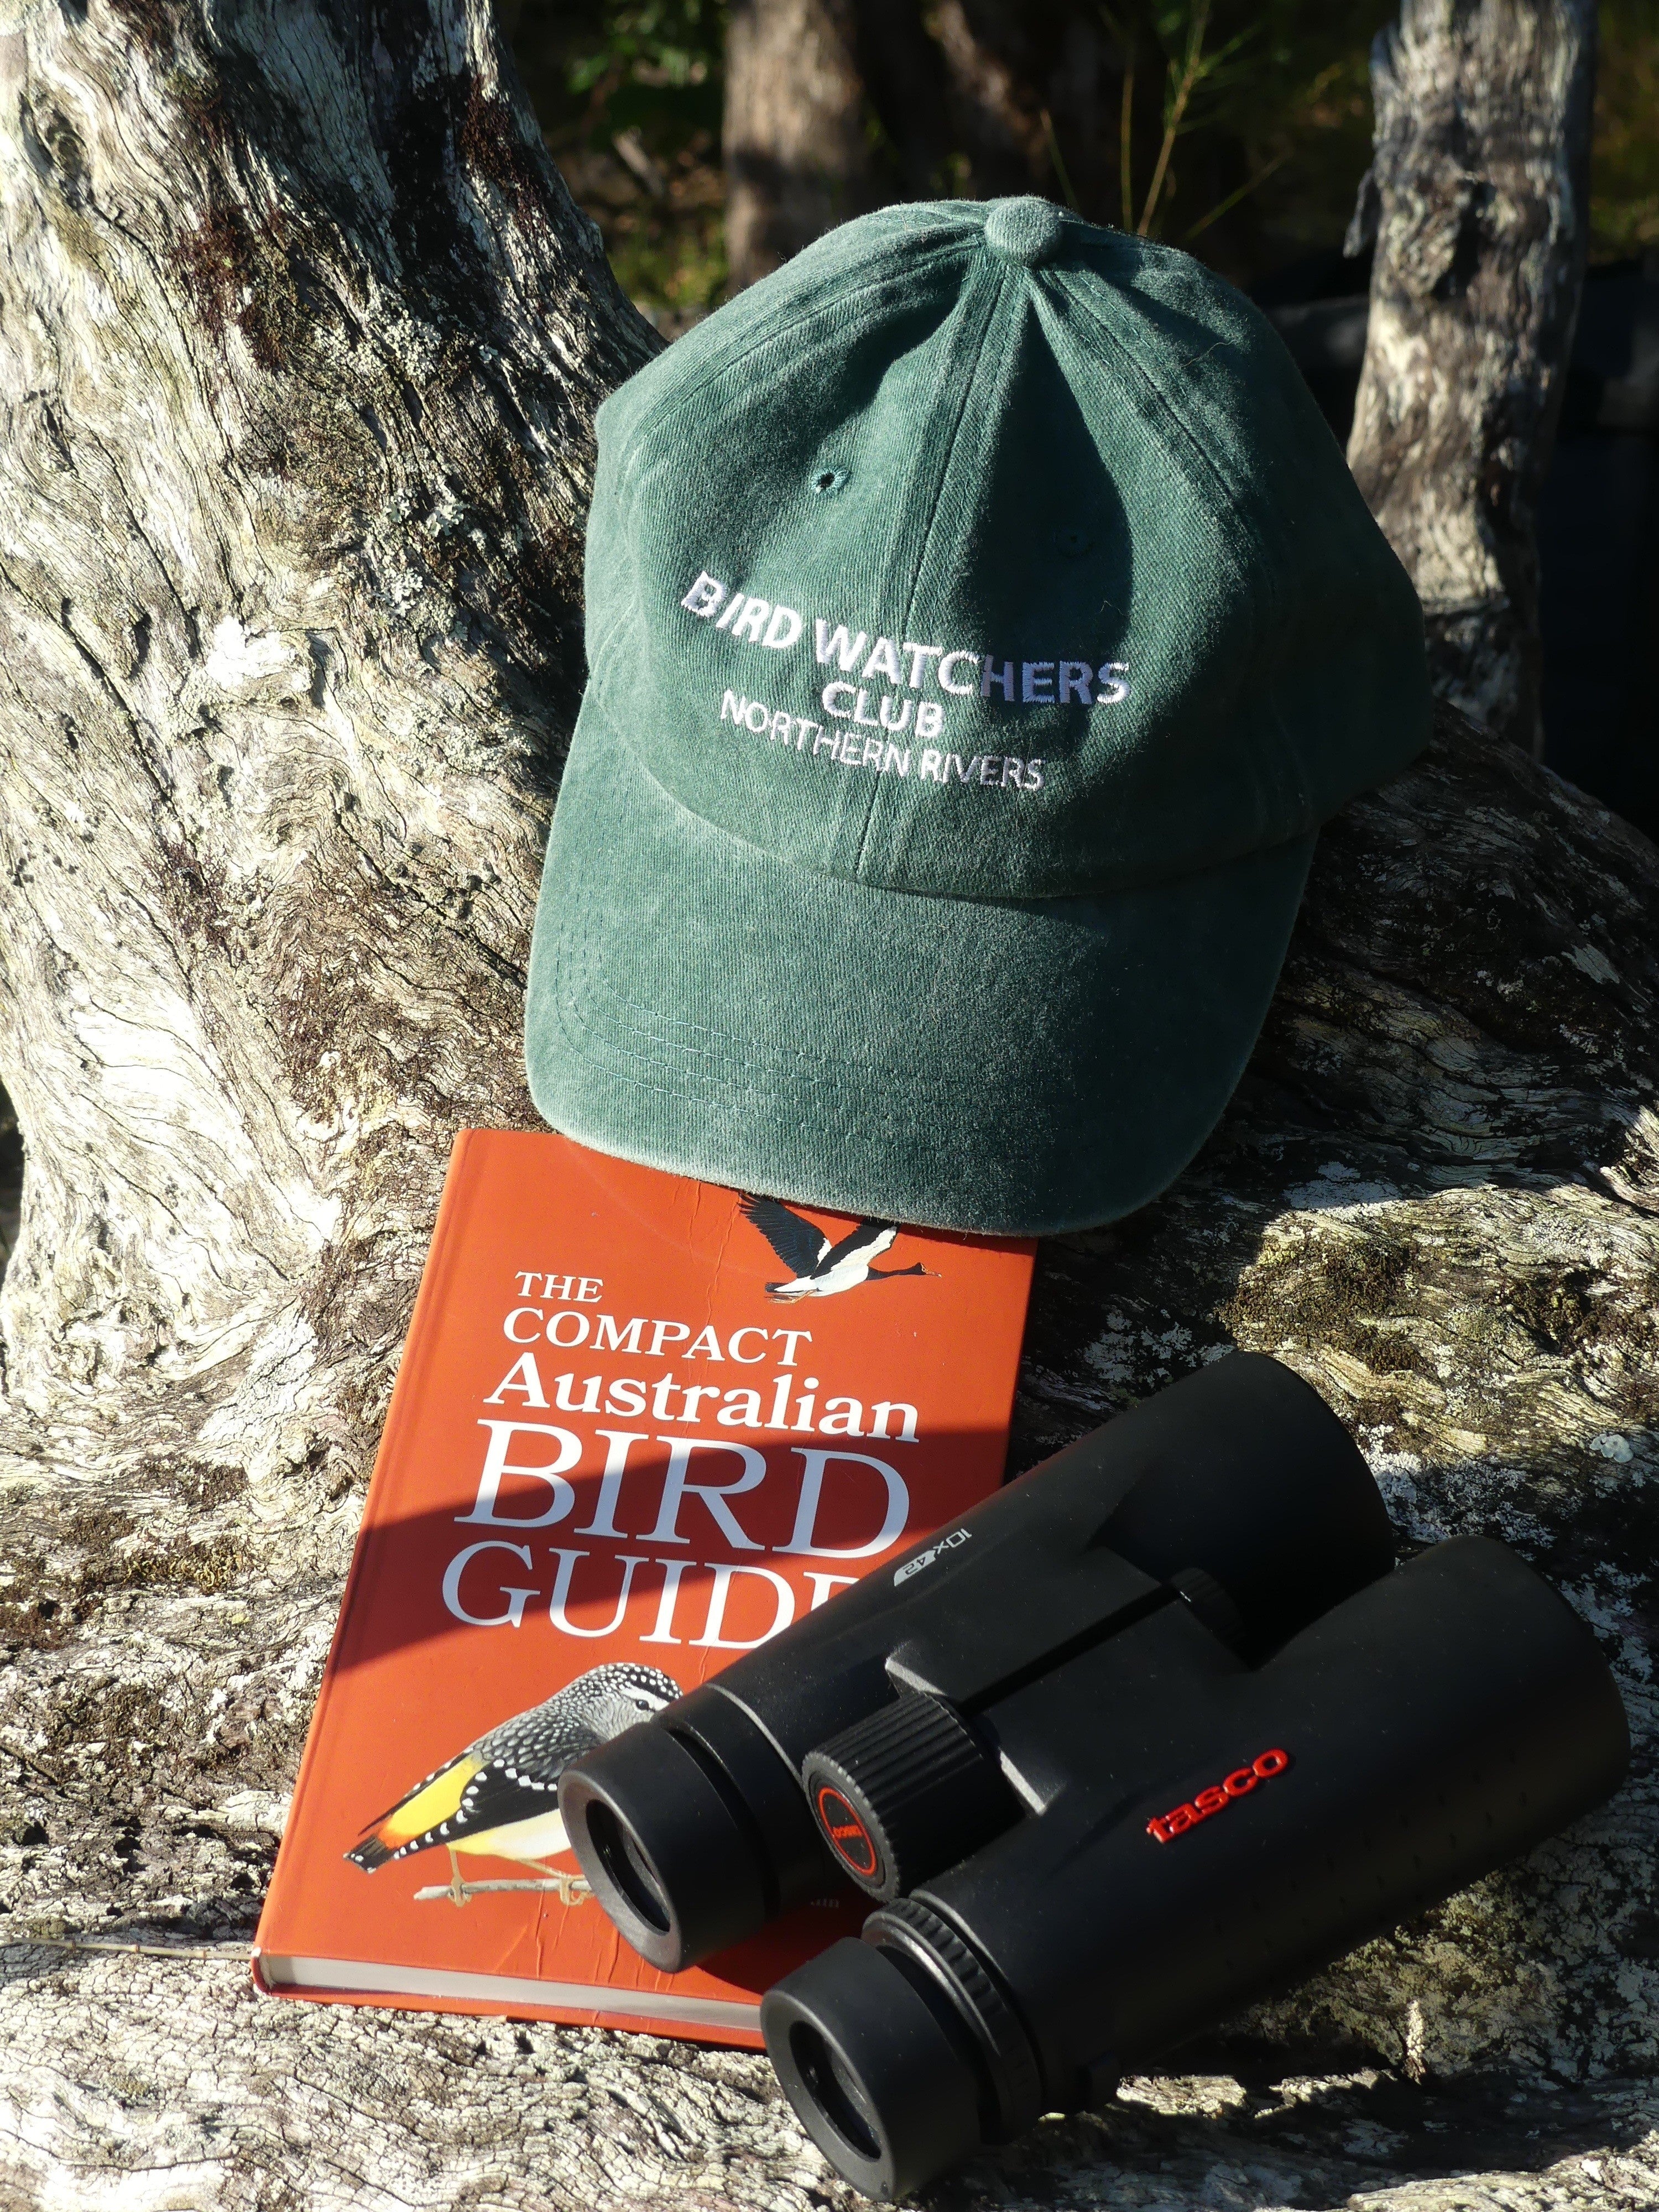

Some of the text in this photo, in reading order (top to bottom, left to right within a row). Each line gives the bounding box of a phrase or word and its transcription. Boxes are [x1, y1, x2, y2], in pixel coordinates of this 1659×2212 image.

[681, 571, 1130, 705] BIRD WATCHERS
[721, 690, 1046, 790] NORTHERN RIVERS
[822, 681, 945, 738] CLUB
[514, 1271, 604, 1303] THE
[503, 1308, 812, 1366] COMPACT
[484, 1352, 920, 1443] Australian
[453, 1419, 910, 1558] BIRD
[1146, 1748, 1288, 1843] tasco
